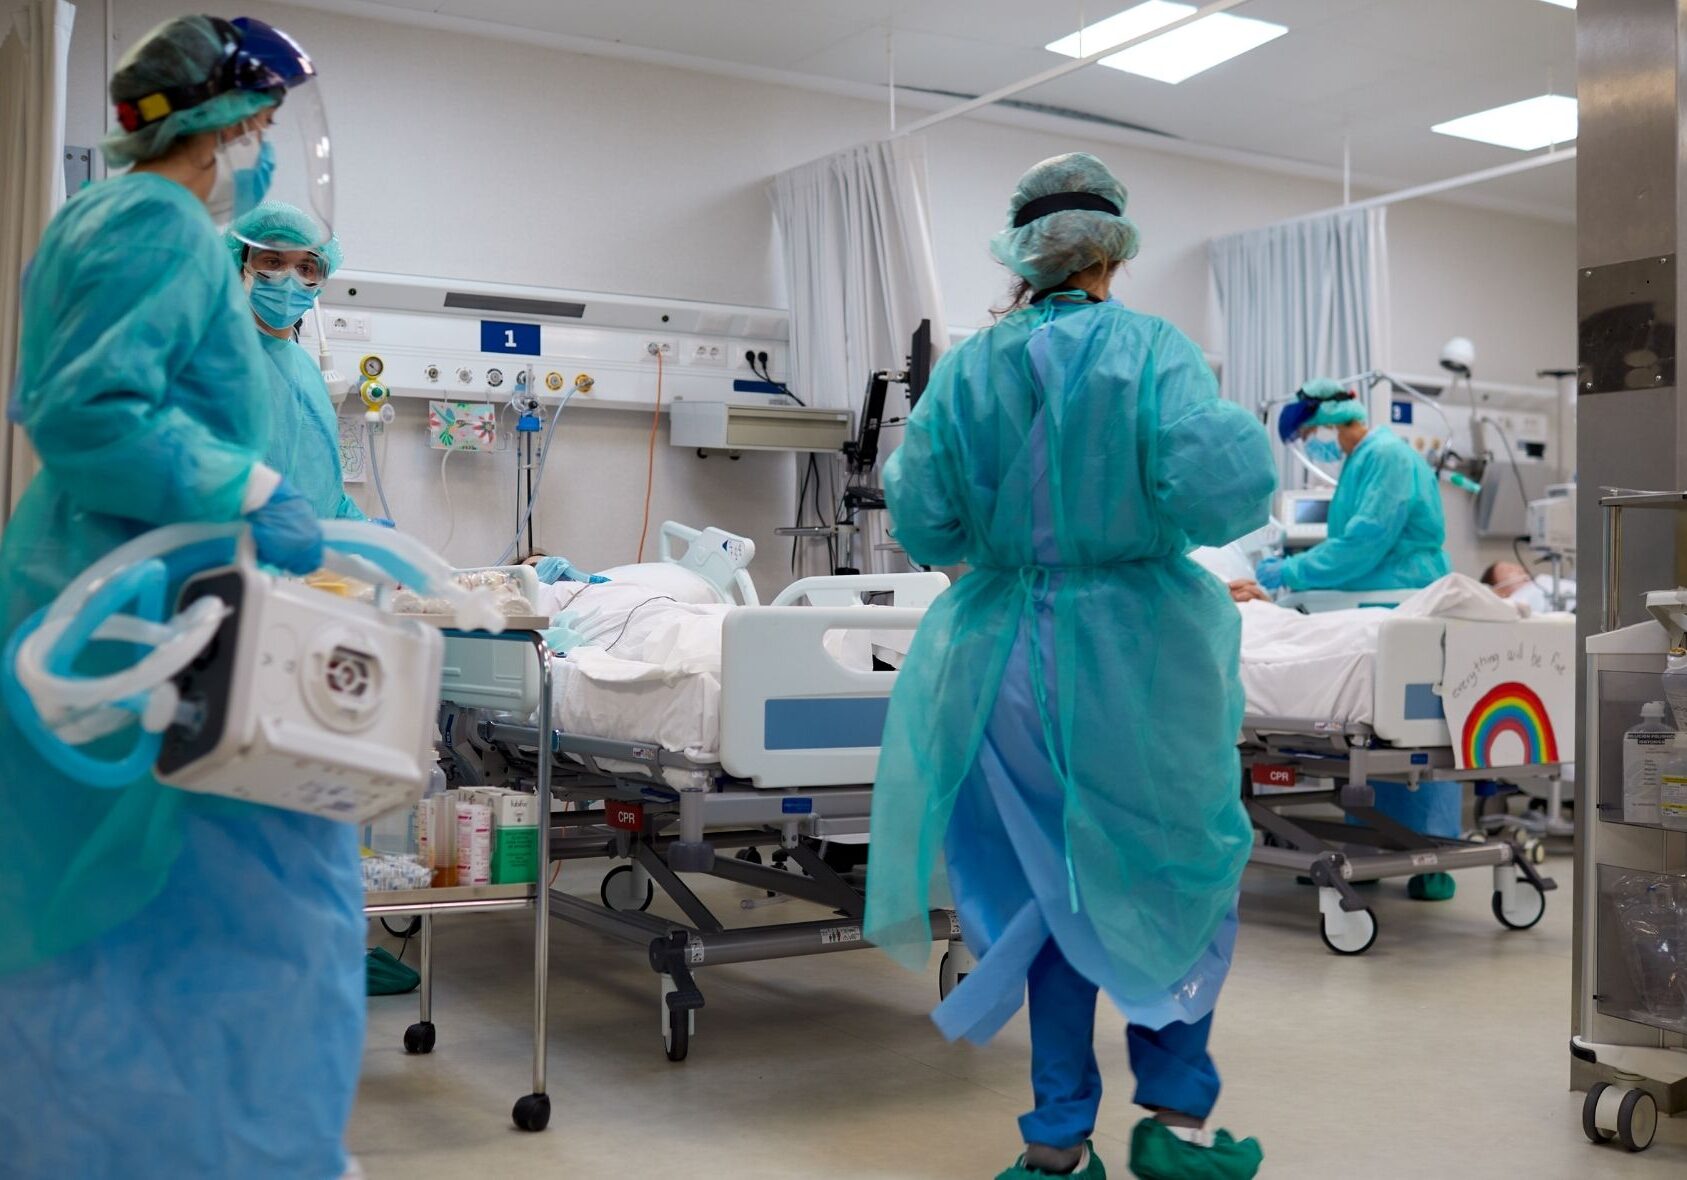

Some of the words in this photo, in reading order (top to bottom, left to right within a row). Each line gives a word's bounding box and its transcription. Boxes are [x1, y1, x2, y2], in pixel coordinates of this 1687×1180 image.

[505, 330, 517, 347] 1
[1452, 653, 1499, 698] everything
[1270, 771, 1289, 782] CPR
[618, 811, 635, 824] CPR
